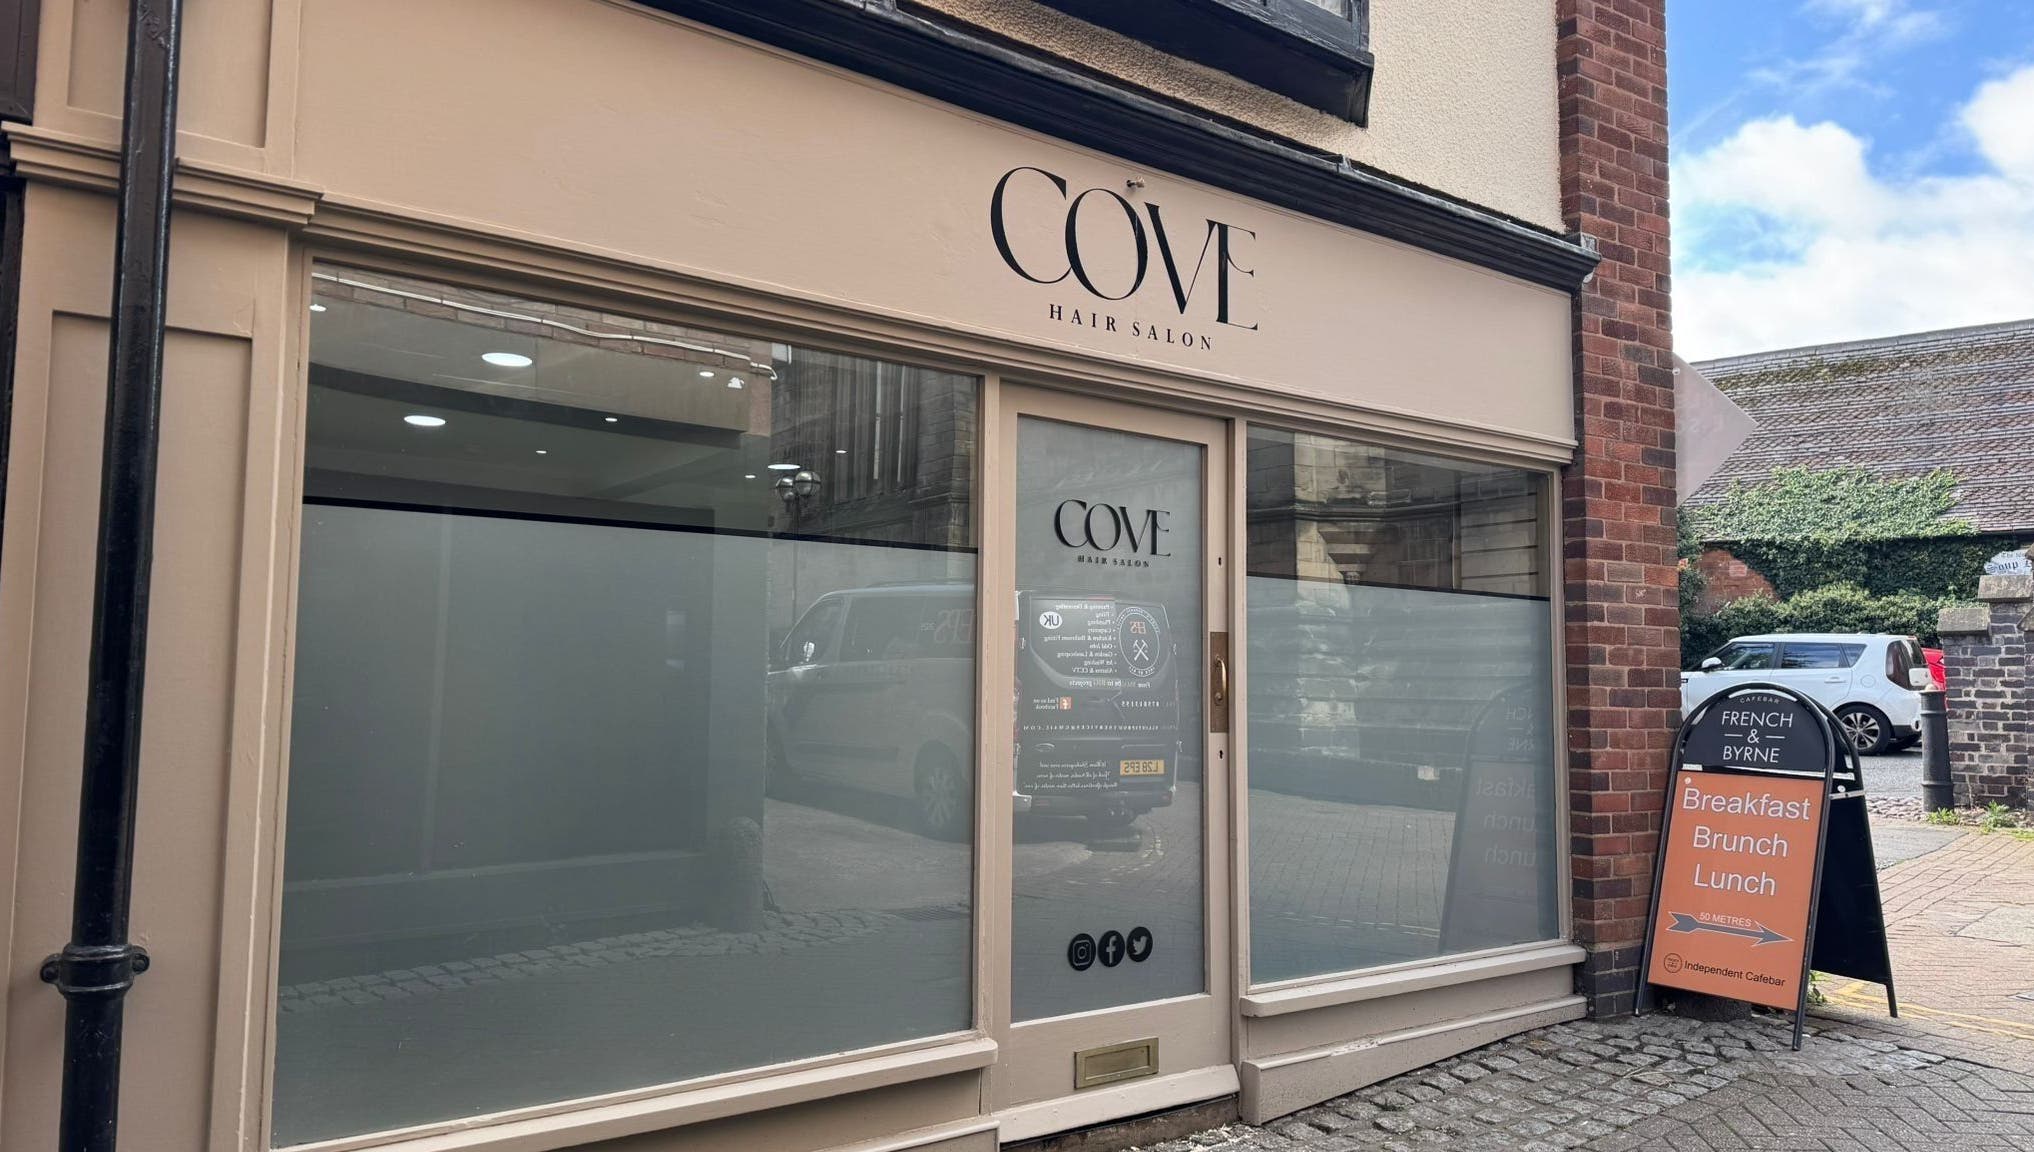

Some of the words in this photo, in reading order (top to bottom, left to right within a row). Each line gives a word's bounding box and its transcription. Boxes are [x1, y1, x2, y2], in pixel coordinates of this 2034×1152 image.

[990, 166, 1258, 331] COVE
[1049, 303, 1117, 332] HAIR
[1132, 321, 1212, 350] SALON
[1054, 499, 1171, 557] COVE
[1077, 555, 1107, 565] HAIR
[1113, 558, 1149, 567] SALON
[1740, 696, 1780, 704] CAFEBAR
[1721, 711, 1793, 728] FRENCH
[1747, 729, 1759, 744] &
[1723, 745, 1781, 763] BYRNE
[1682, 786, 1811, 820] Breakfast
[1692, 825, 1788, 858] Brunch
[1693, 863, 1776, 896] Lunch
[1700, 912, 1711, 921] 50
[1712, 914, 1752, 927] METRES
[1684, 960, 1743, 979] Independent
[1745, 971, 1786, 986] Cafebar
